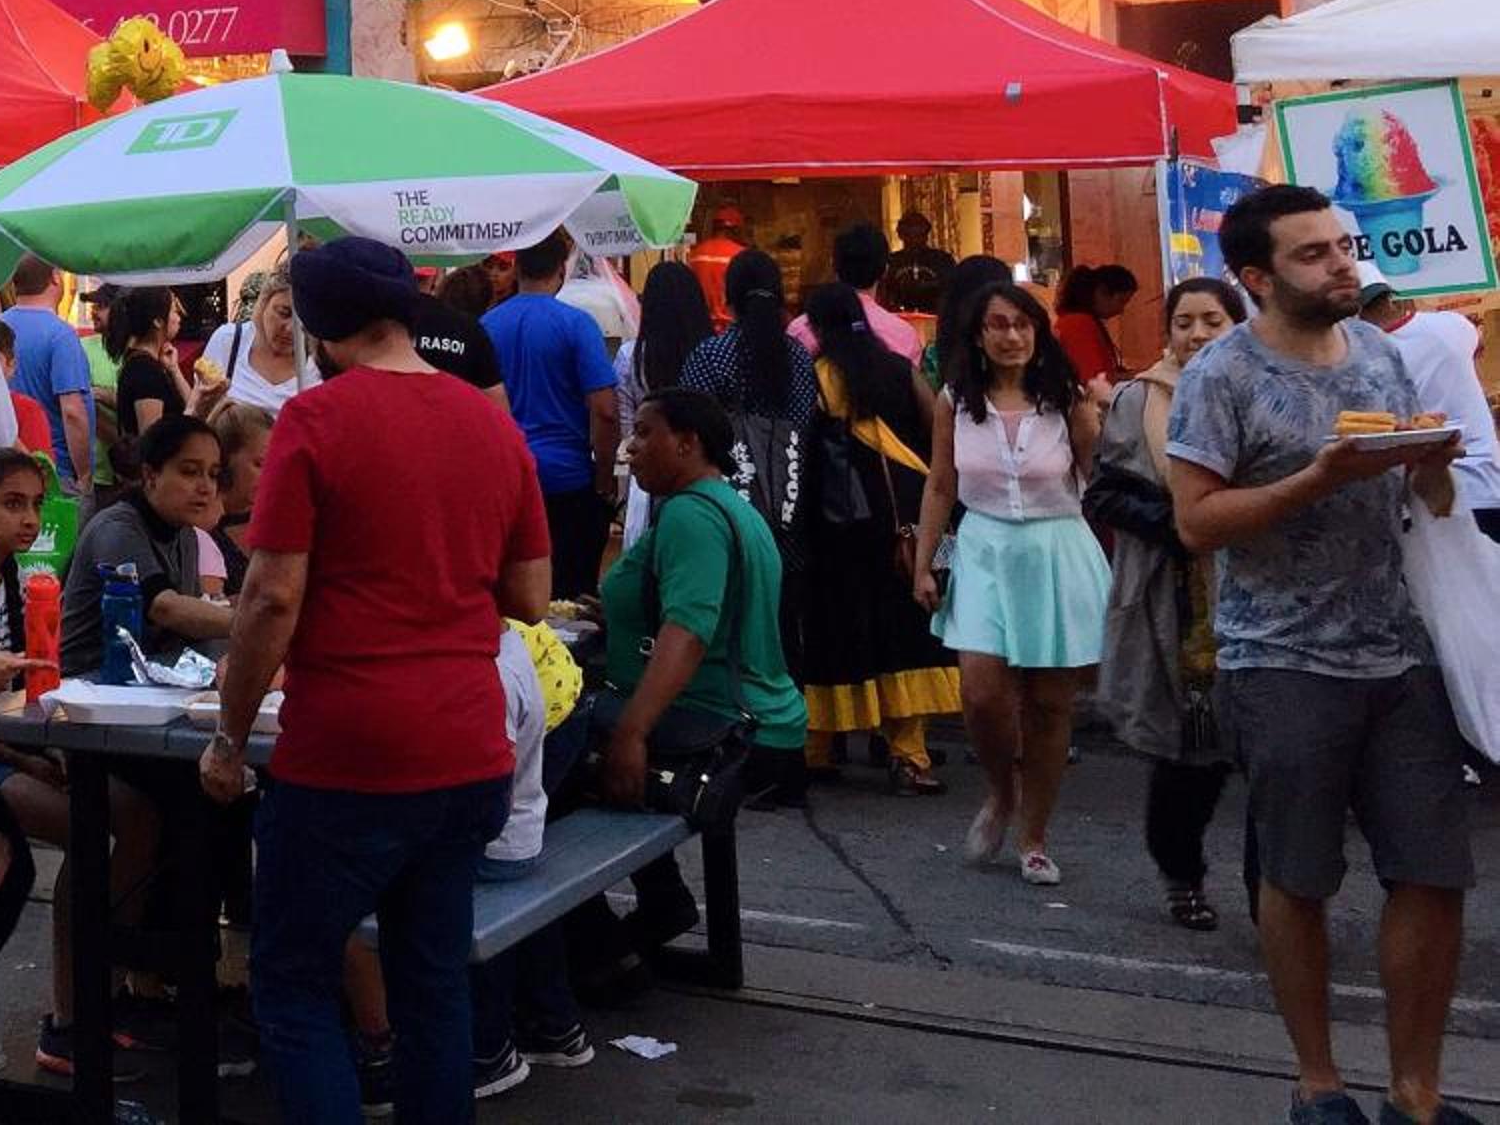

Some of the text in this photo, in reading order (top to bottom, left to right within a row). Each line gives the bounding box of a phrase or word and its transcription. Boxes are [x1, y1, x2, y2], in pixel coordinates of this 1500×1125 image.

[394, 190, 431, 207] THE
[398, 205, 456, 225] READY
[400, 221, 524, 244] COMMITMENT
[1381, 224, 1468, 258] GOLA
[420, 336, 465, 355] RASOI
